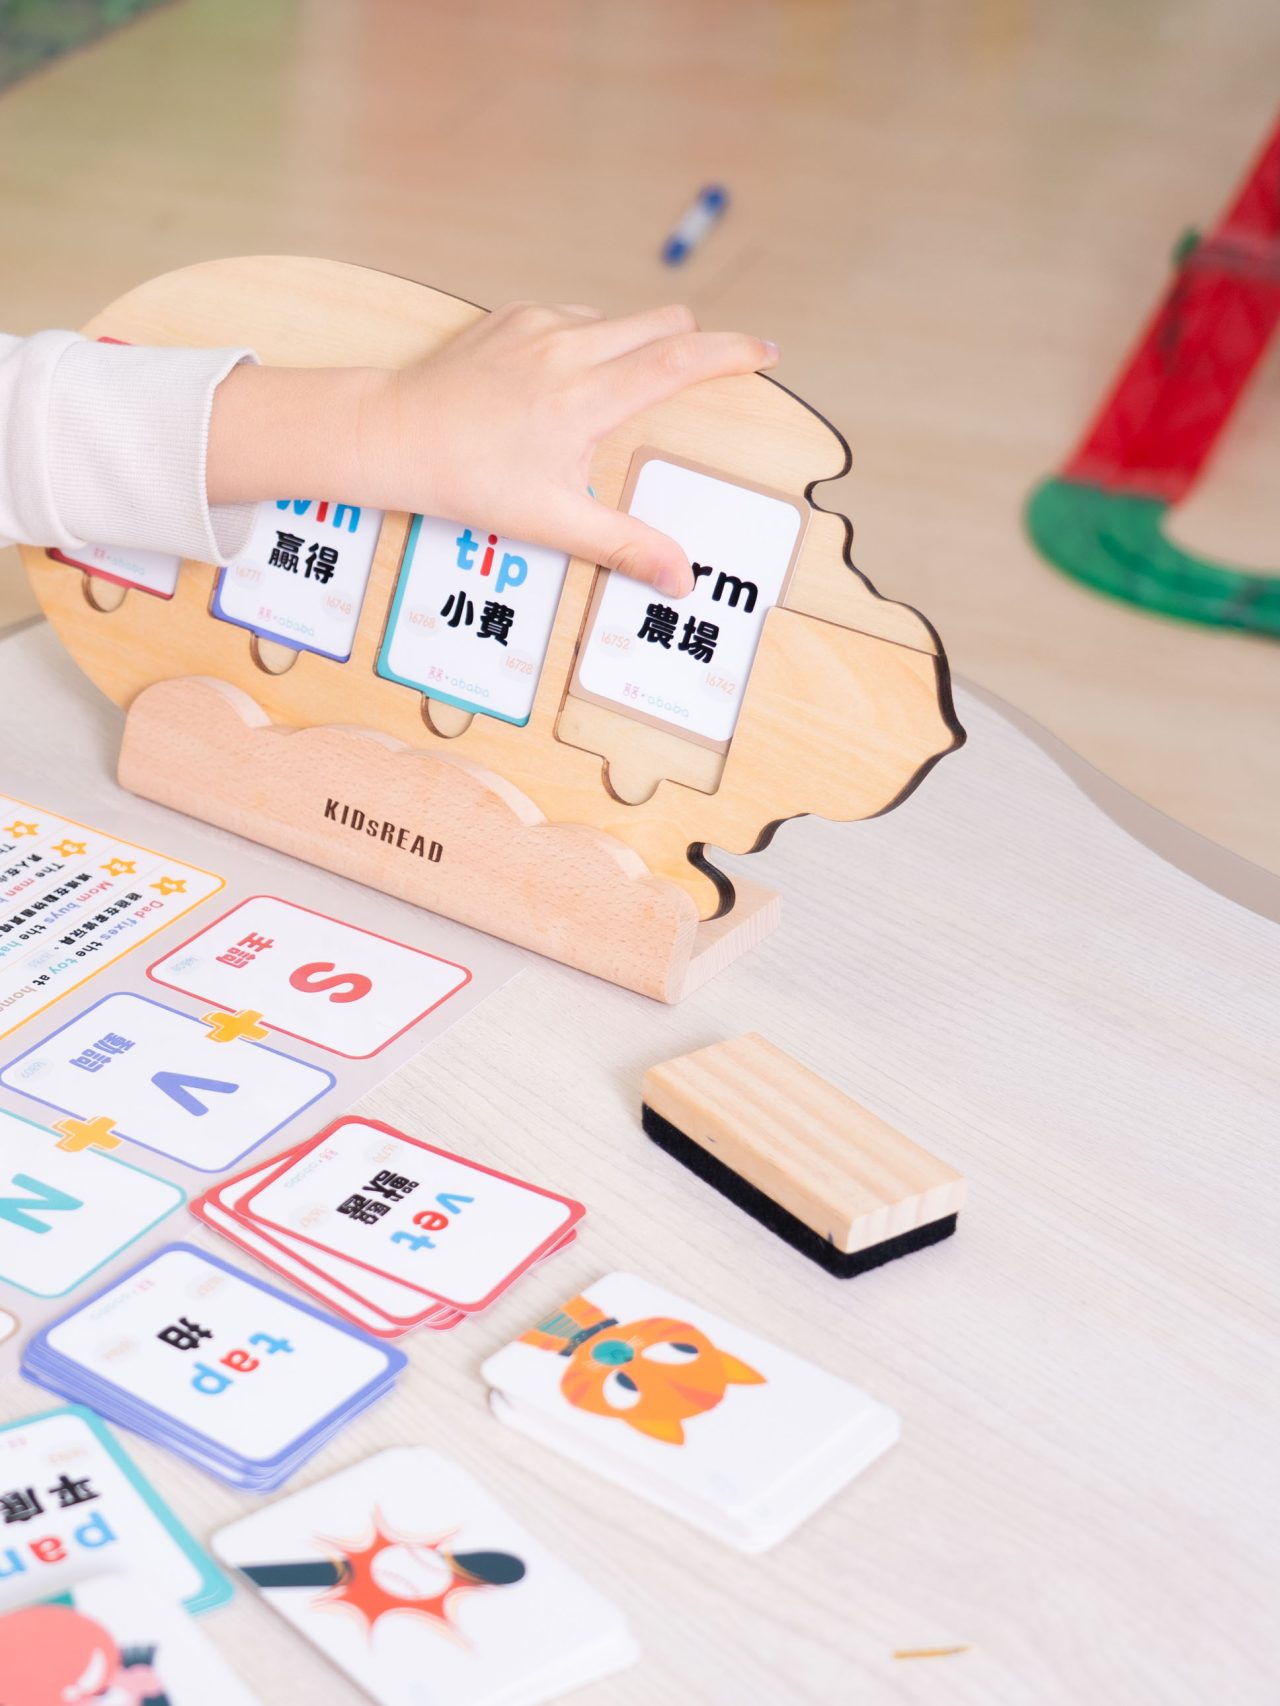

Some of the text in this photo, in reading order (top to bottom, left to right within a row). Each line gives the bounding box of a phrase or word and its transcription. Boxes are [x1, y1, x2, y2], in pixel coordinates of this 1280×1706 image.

[268, 530, 340, 585] 贏得
[456, 529, 528, 593] tip
[691, 562, 759, 613] rm
[440, 590, 515, 647] 小費
[637, 603, 720, 664] 農場
[600, 631, 631, 651] 16752
[504, 654, 534, 676] 16728
[704, 671, 737, 697] 16742
[34, 862, 65, 878] The
[4, 877, 35, 897] man
[76, 880, 114, 902] Mom
[43, 902, 81, 924] buys
[133, 899, 165, 919] Dad
[18, 924, 47, 940] the
[99, 917, 138, 941] fixes
[75, 941, 103, 957] the
[215, 931, 275, 969] 主詞
[32, 974, 51, 986] at
[48, 957, 79, 975] toy
[288, 961, 373, 1004] S
[68, 1032, 136, 1073] 動詞
[150, 1070, 240, 1117] V
[335, 1169, 420, 1225] 獸醫
[390, 1192, 475, 1252] vet
[156, 1317, 213, 1351] 拍
[191, 1332, 295, 1396] tap
